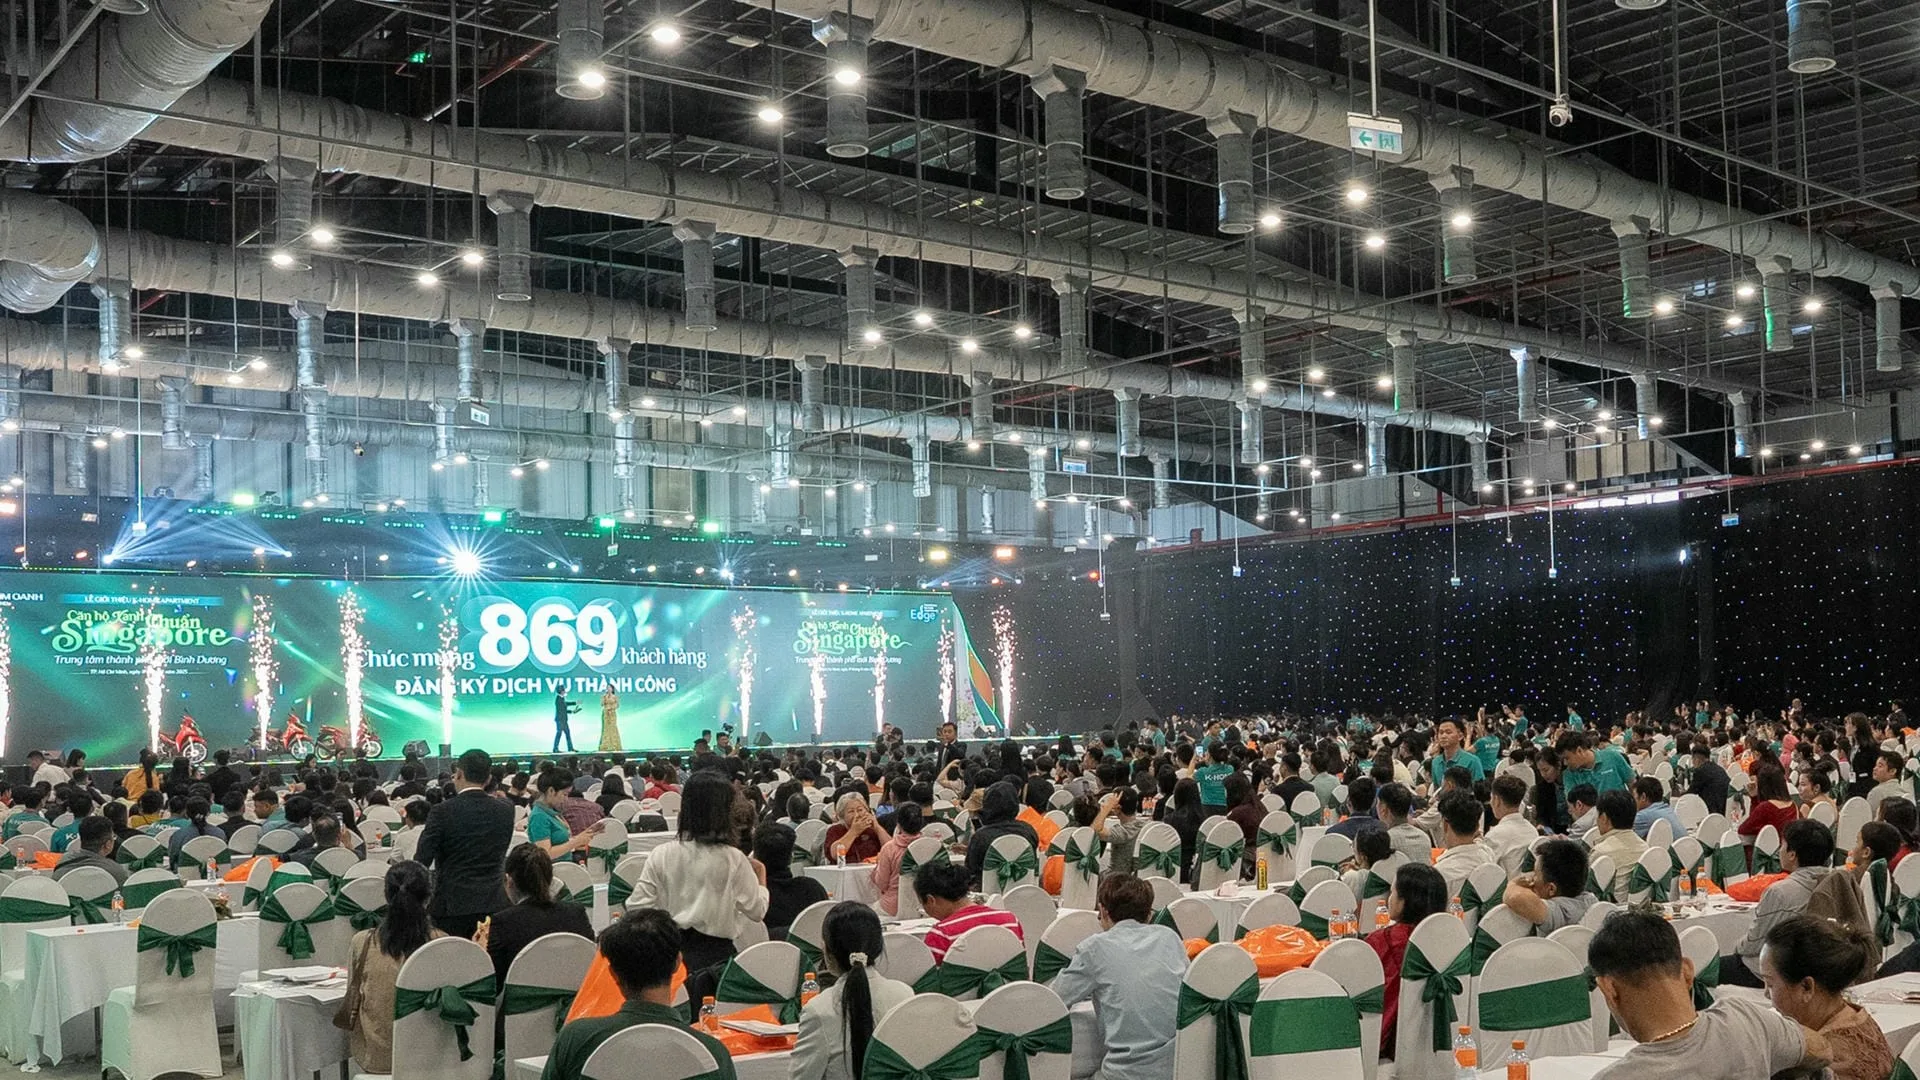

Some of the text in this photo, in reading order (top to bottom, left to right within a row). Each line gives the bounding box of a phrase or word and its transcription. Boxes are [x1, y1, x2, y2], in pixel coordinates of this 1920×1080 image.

[12, 593, 44, 601] OANH
[67, 609, 93, 621] Căn
[910, 604, 936, 623] Edge
[479, 603, 619, 666] 869
[54, 655, 83, 665] Trung
[621, 647, 666, 665] khách
[668, 647, 707, 669] hàng
[395, 676, 456, 695] ĐĂN
[461, 675, 488, 694] KÝ
[492, 677, 542, 697] DỊCH
[575, 674, 632, 693] THÀNH
[634, 674, 677, 693] CÔNG
